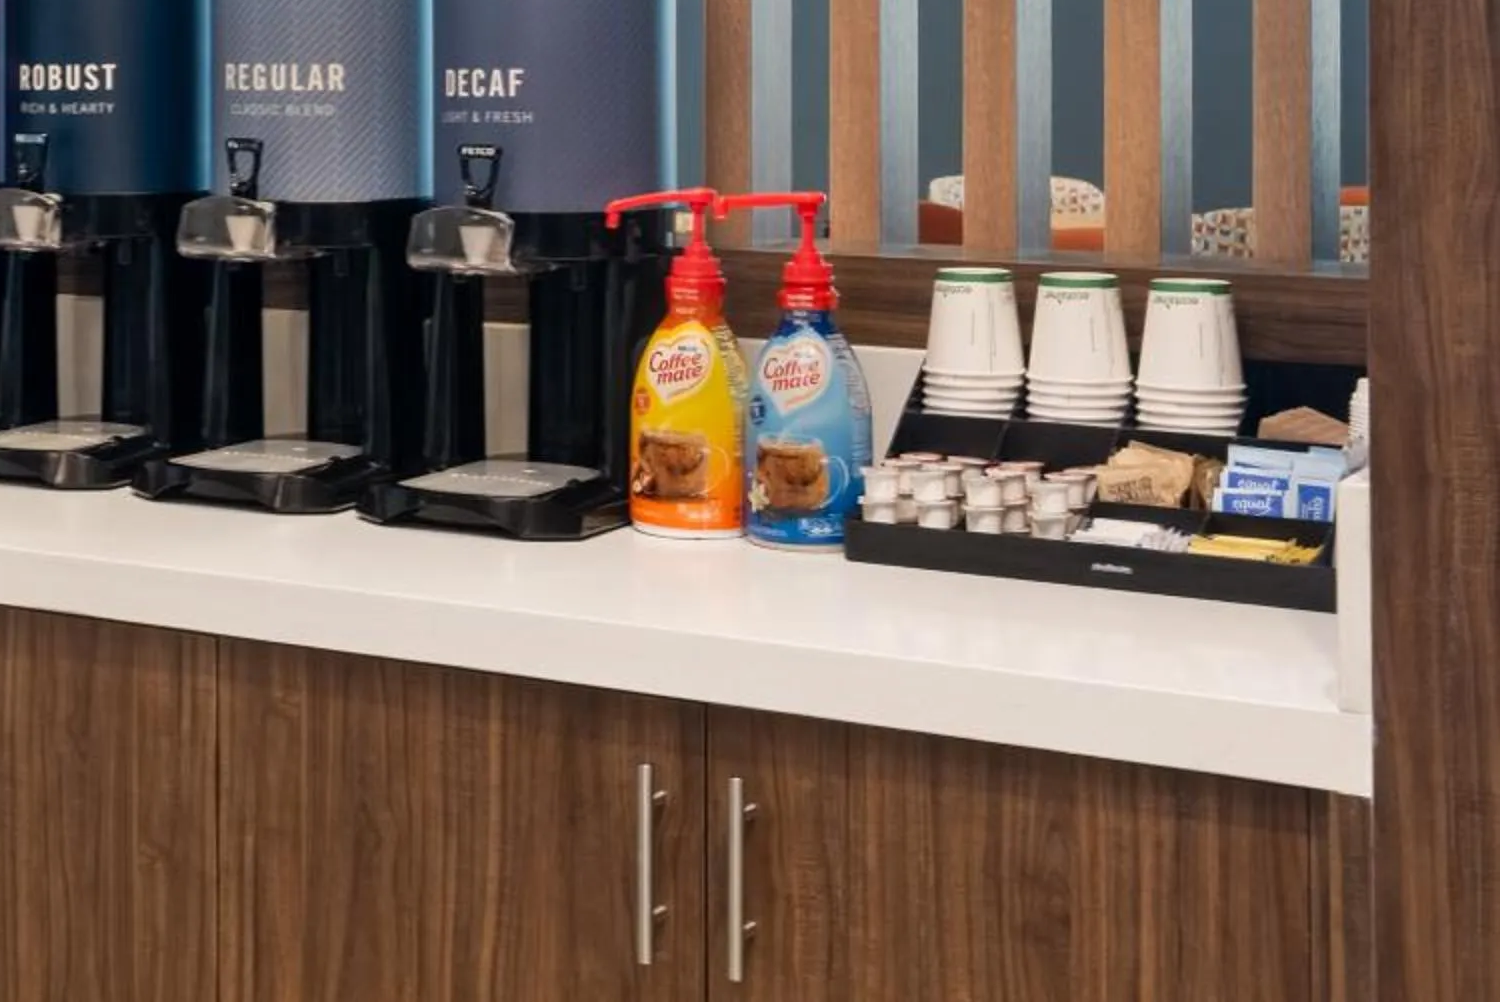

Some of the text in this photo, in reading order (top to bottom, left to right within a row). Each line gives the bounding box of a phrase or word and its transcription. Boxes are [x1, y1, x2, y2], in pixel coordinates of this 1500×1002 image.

[19, 63, 117, 91] ROBUST
[225, 63, 345, 92] REGULAR
[445, 68, 524, 97] DECAF
[61, 102, 115, 115] HEARTY
[484, 110, 534, 123] FRESH
[649, 351, 703, 373] Coffee
[657, 365, 703, 385] mate
[772, 373, 821, 393] mate
